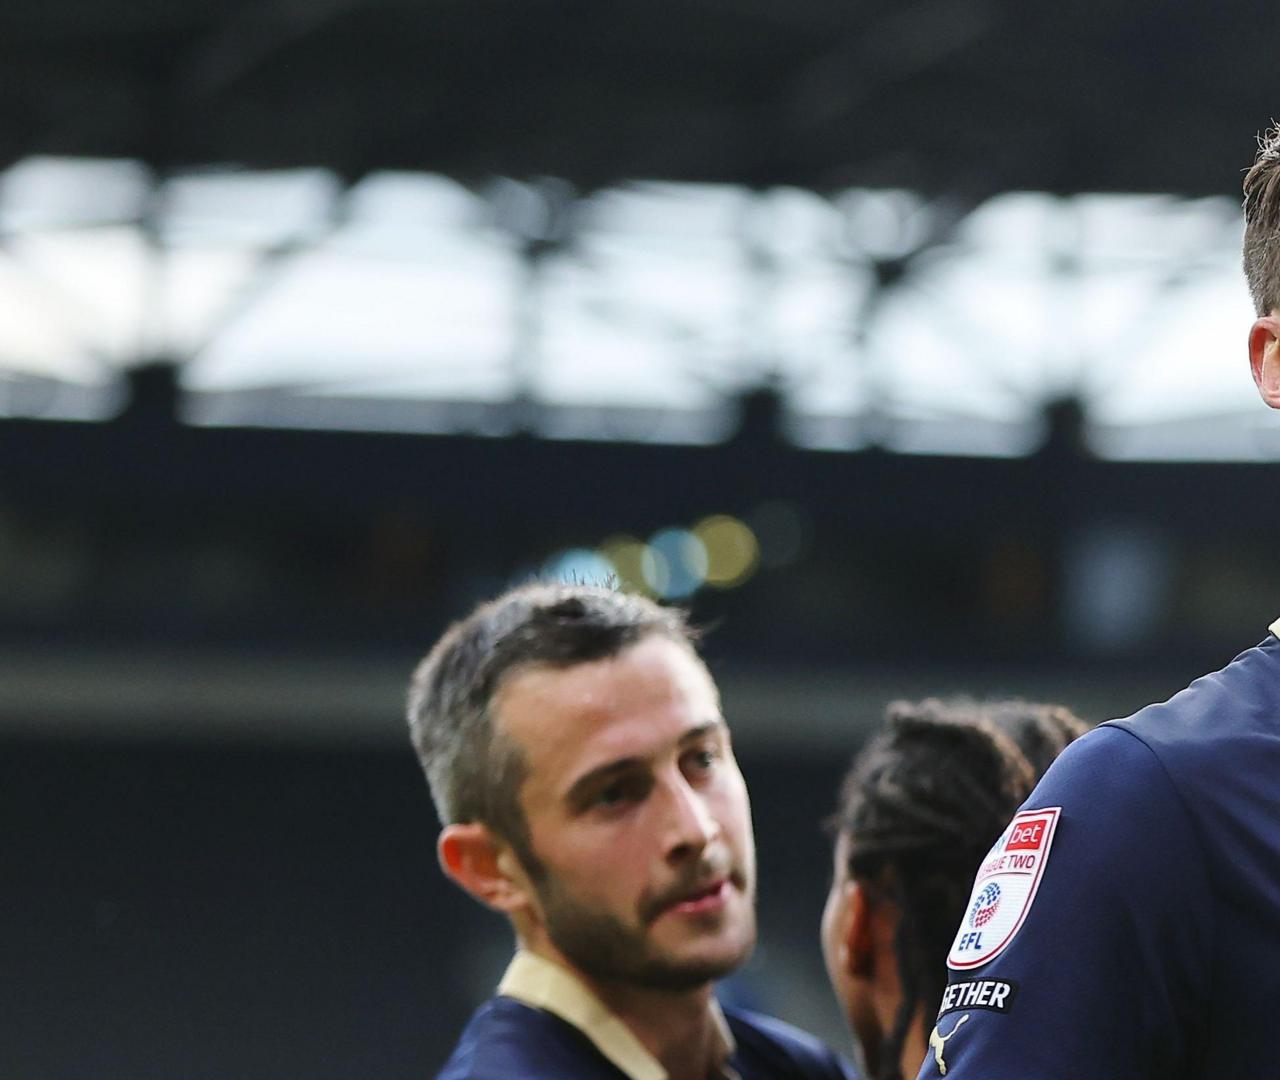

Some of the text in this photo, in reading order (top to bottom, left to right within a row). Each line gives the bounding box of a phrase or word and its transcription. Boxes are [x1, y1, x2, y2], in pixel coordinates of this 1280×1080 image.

[1009, 824, 1041, 845] bet
[1008, 854, 1036, 870] TWO
[958, 931, 982, 951] EFL
